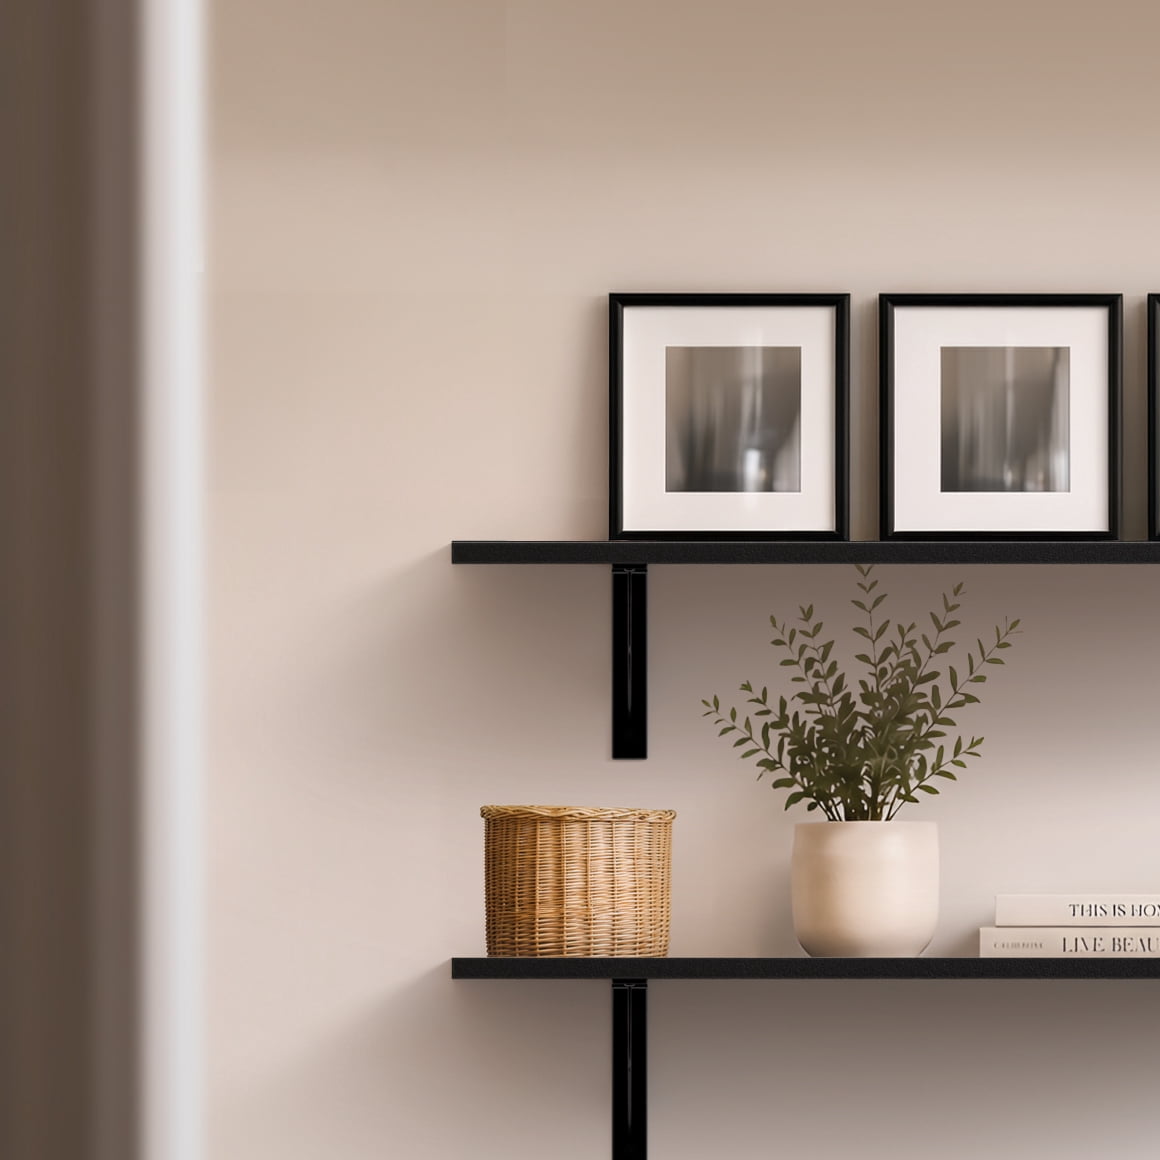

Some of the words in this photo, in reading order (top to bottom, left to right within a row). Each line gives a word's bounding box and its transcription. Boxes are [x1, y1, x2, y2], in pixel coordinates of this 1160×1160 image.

[1068, 903, 1108, 917] THIS
[1112, 903, 1126, 917] IS
[1062, 936, 1106, 953] LIVE
